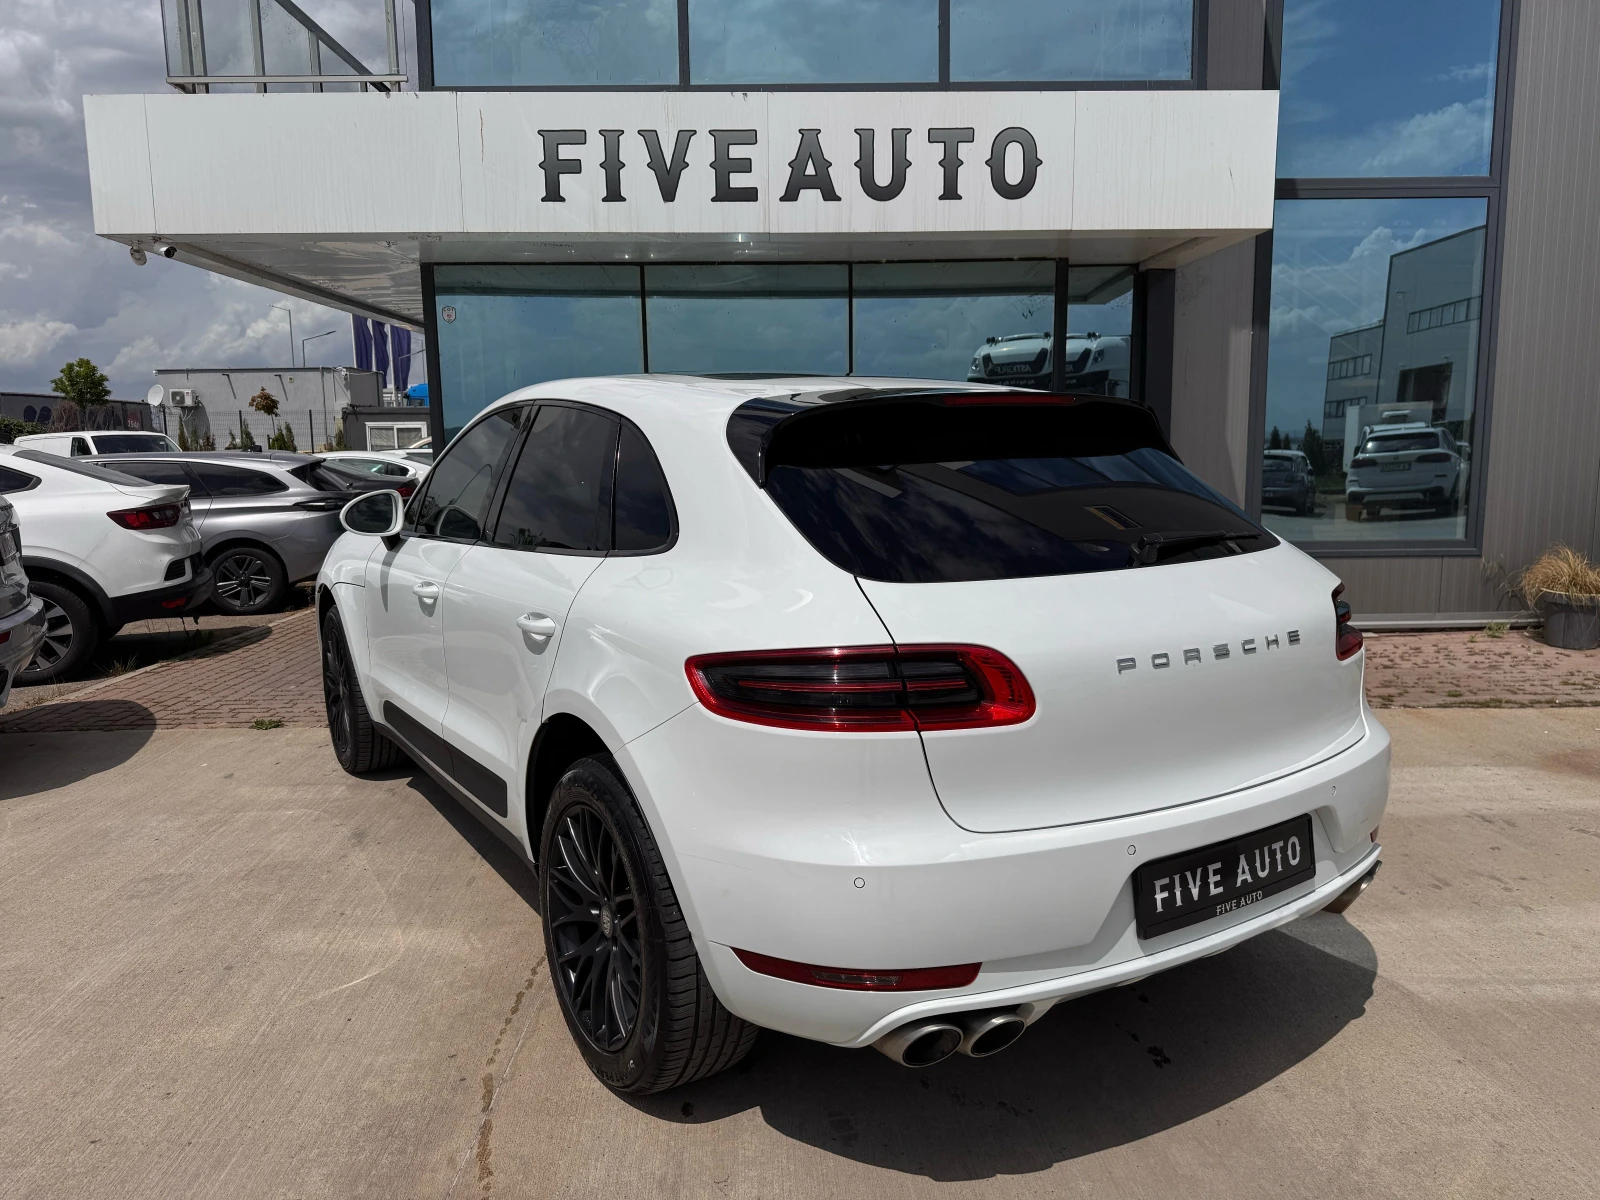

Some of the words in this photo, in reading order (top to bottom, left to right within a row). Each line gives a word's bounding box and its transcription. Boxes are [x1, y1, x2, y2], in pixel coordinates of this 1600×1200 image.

[1116, 629, 1301, 675] PORSCHE
[1153, 861, 1224, 913] FIVE
[1235, 835, 1301, 888] AUTO
[1215, 899, 1237, 916] FIVE
[1239, 890, 1263, 907] AUTO
